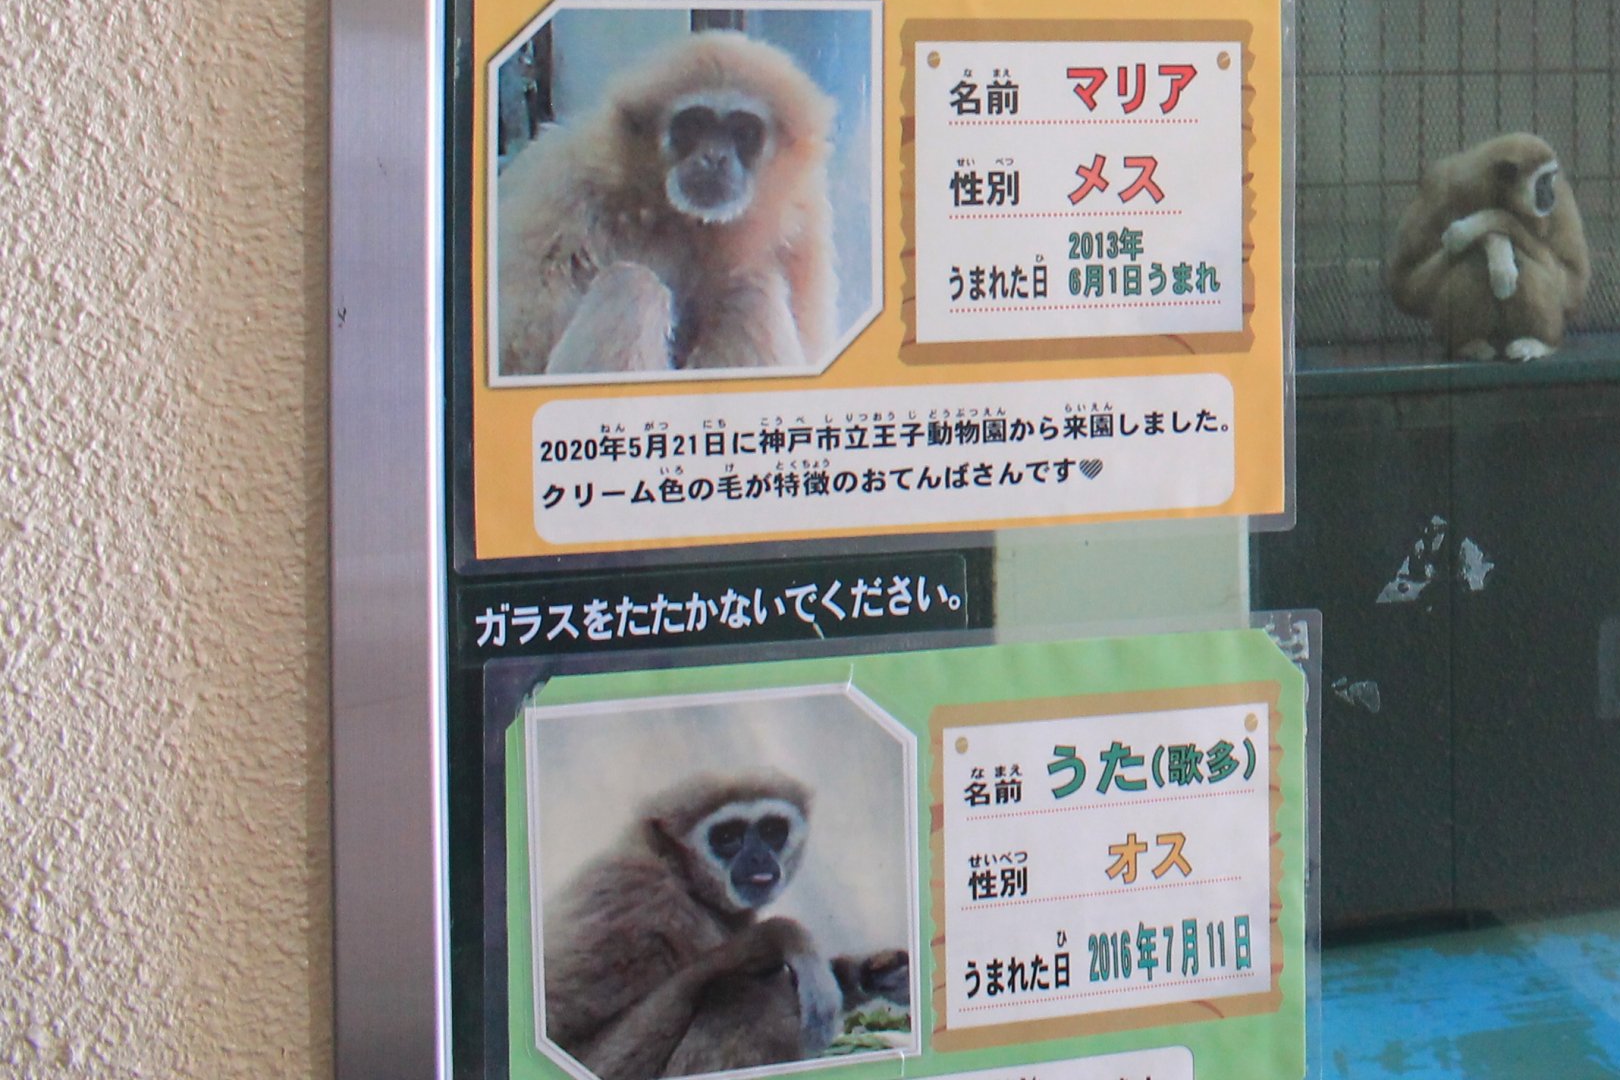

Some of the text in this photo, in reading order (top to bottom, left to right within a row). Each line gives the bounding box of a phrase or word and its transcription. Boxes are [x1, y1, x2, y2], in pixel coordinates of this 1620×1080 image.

[949, 63, 1198, 115] 名前 マリア
[949, 153, 1165, 207] 性別 メス
[1068, 227, 1145, 262] 2013年
[949, 261, 1221, 301] うまれた日 6月1日うまれ
[540, 409, 1229, 463] 2020年5月21日に神戸市立王子動物園から来園しました。
[475, 575, 962, 648] ガラスをたたかないでください。
[964, 738, 1256, 807] 名前 うた(歌多)
[968, 832, 1193, 901] 性別 オス
[964, 915, 1251, 999] うまれた日 2016年7月11日
